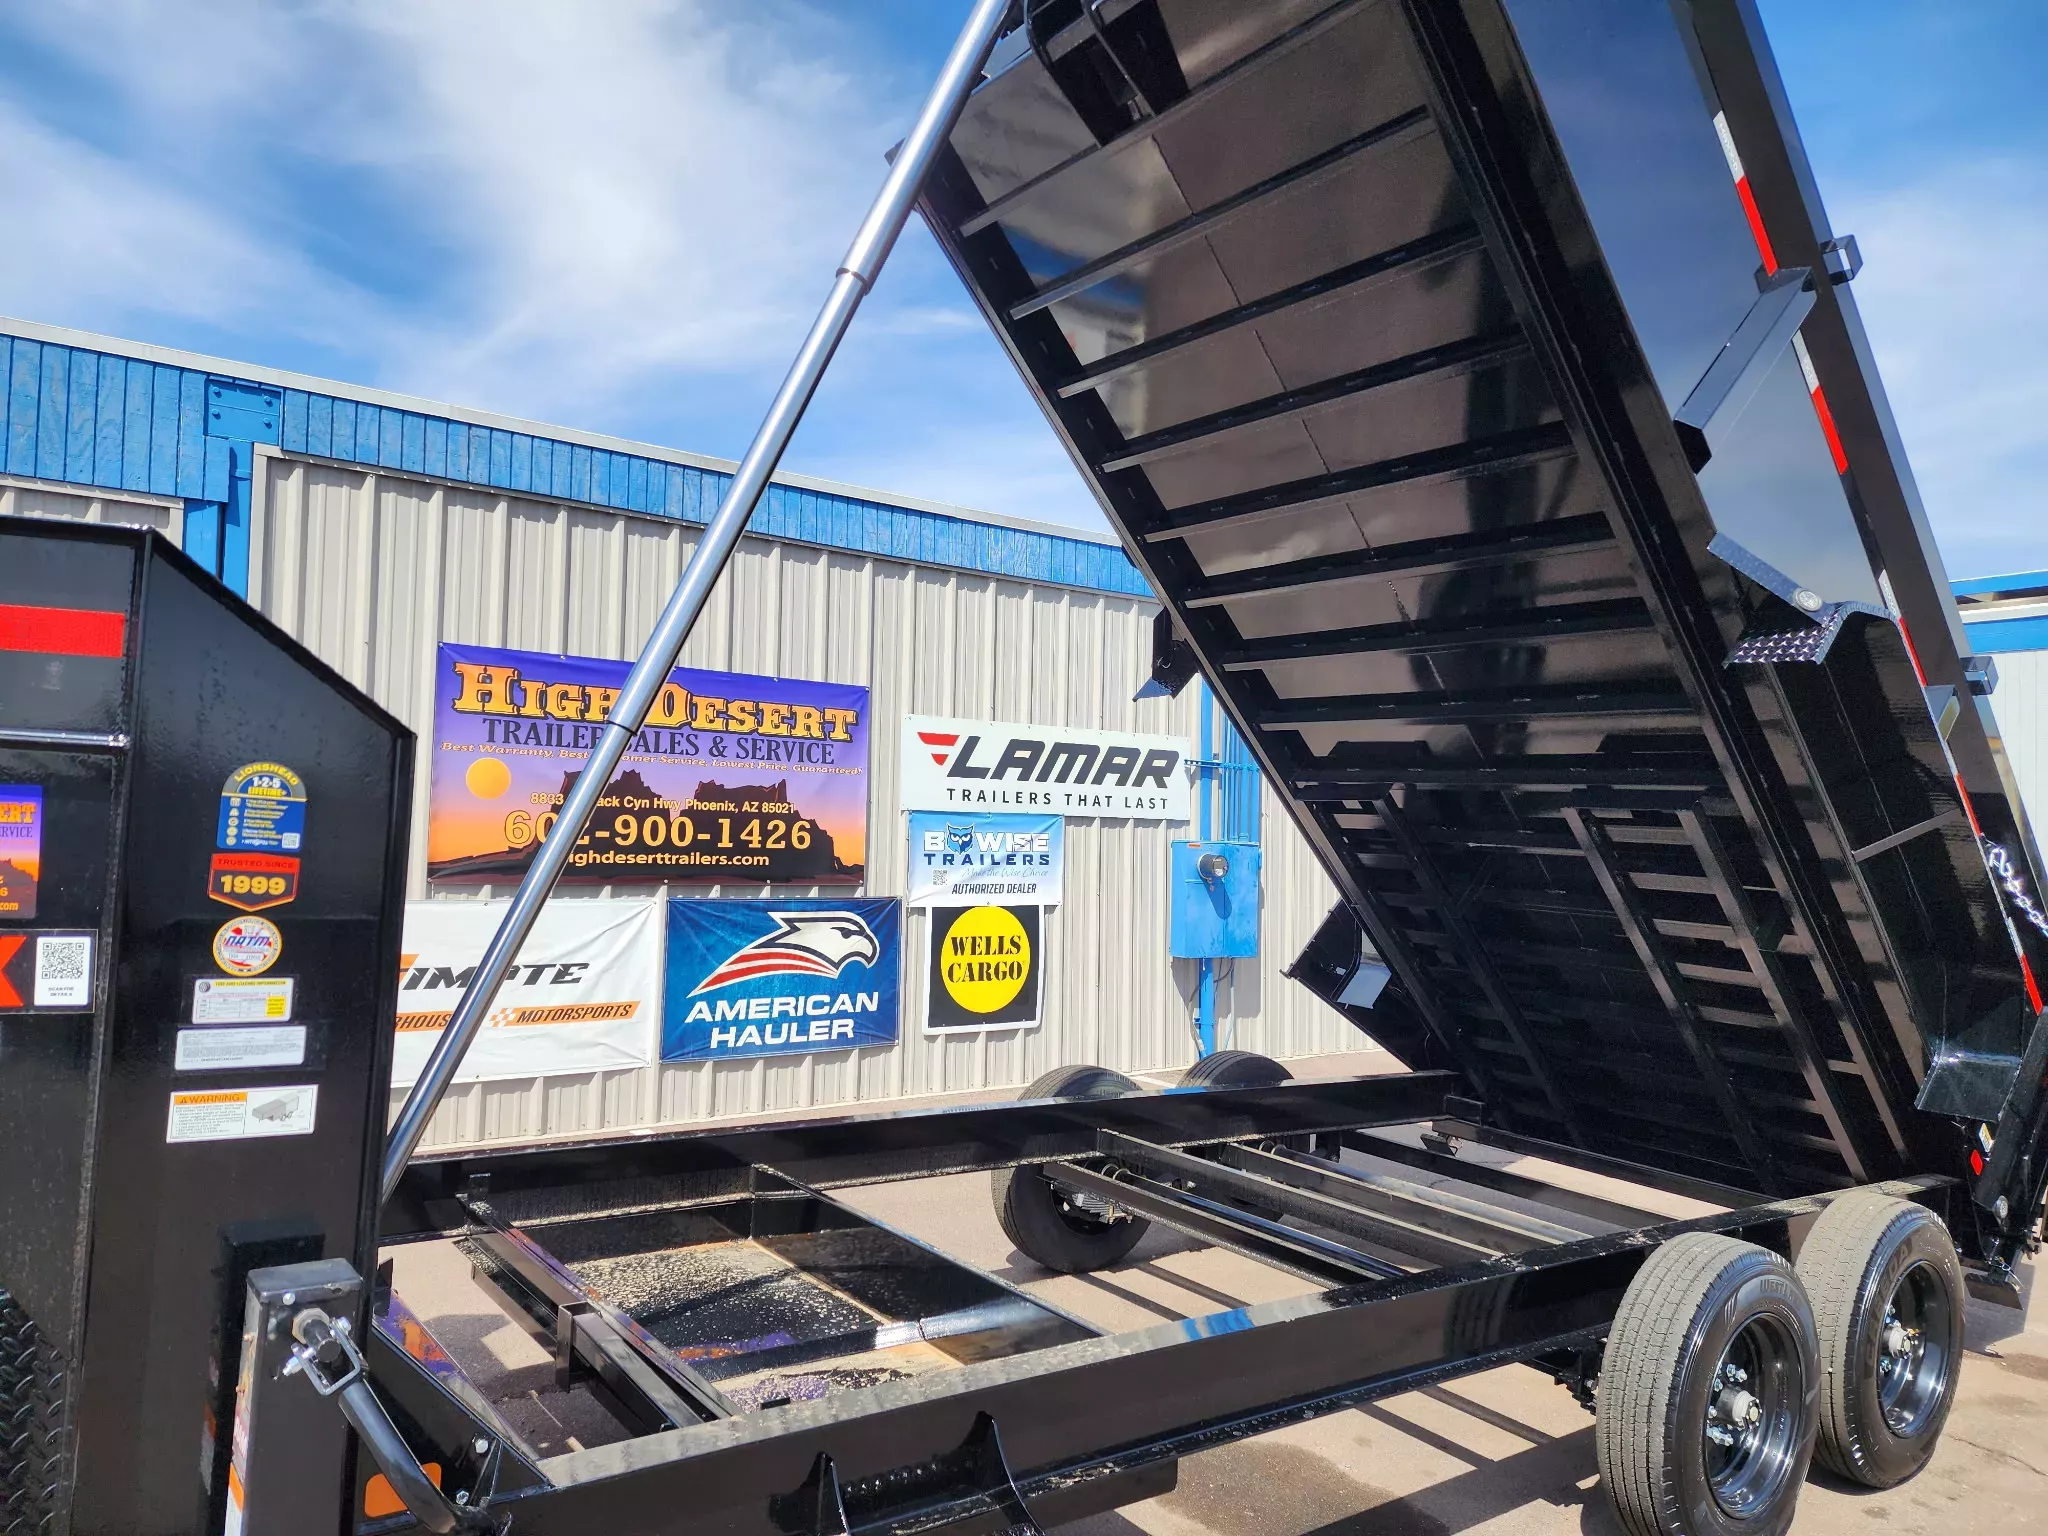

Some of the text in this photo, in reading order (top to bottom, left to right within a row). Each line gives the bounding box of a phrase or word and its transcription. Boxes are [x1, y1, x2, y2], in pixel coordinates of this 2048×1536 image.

[452, 661, 859, 743] HIGH DESERT
[626, 730, 700, 757] ALES
[708, 735, 728, 758] &
[736, 737, 835, 765] SERVICE
[441, 742, 474, 752] Best
[558, 750, 589, 760] Best
[620, 755, 657, 764] omer
[711, 759, 755, 769] Lowest
[793, 764, 863, 776] Guaranteed!
[947, 735, 1180, 789] LAMAR
[234, 763, 300, 787] LIONSHEAD
[597, 795, 621, 808] ack
[623, 796, 650, 811] Cyn
[653, 797, 681, 812] Hwy
[685, 798, 739, 814] Phoenix,
[742, 801, 759, 813] AZ
[762, 803, 796, 814] 85021
[947, 788, 1168, 810] TRAILERS THAT LAST
[0, 802, 36, 825] ERT
[0, 826, 33, 838] RVICE
[217, 858, 294, 869] TRUSTED SINCE
[568, 850, 770, 867] ighdeserttrailers.com
[924, 853, 1050, 866] TRAILERS
[220, 874, 287, 895] 1999
[952, 883, 1037, 895] AUTHORIZED DEALER
[951, 935, 1021, 956] WELLS
[948, 960, 1023, 983] CARGO
[516, 1003, 632, 1024] MOTORSPORTS
[684, 991, 879, 1024] AMERICAN
[710, 1018, 855, 1049] HAULER
[189, 1093, 240, 1104] WARNING
